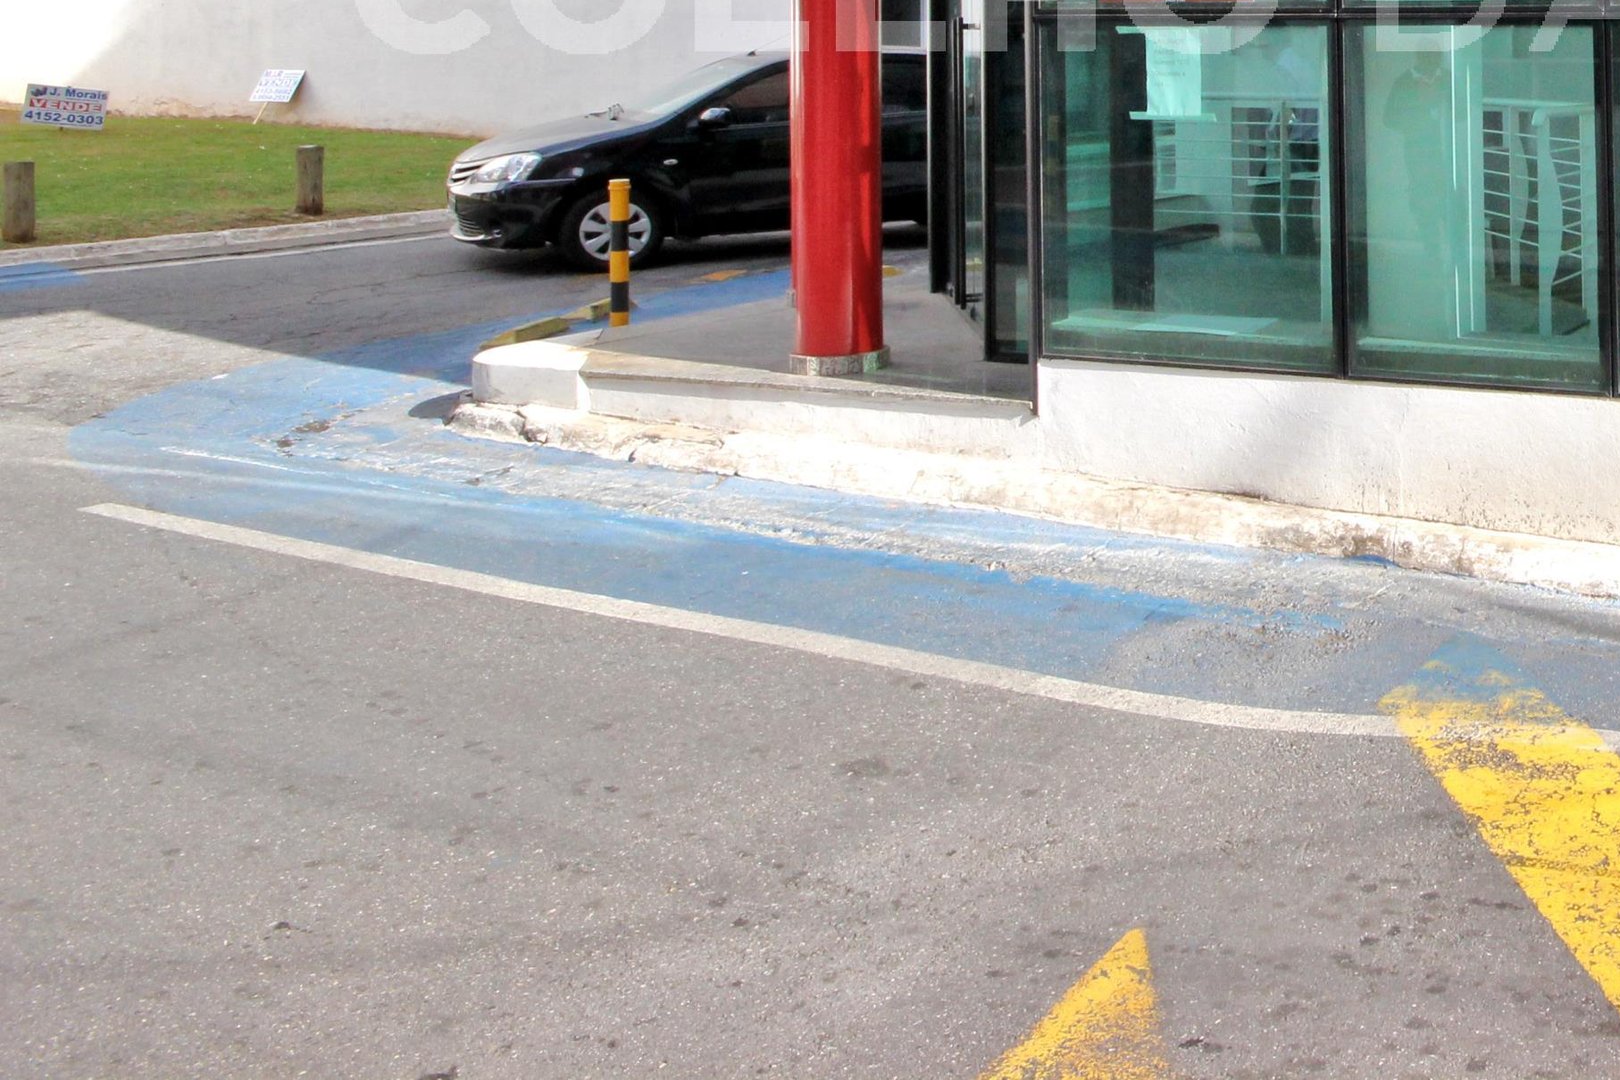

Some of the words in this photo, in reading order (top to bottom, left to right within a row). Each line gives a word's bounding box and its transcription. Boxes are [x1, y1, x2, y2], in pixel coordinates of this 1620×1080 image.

[65, 88, 108, 100] Morais
[30, 98, 102, 112] VENDE
[24, 110, 104, 125] 4152-0303
